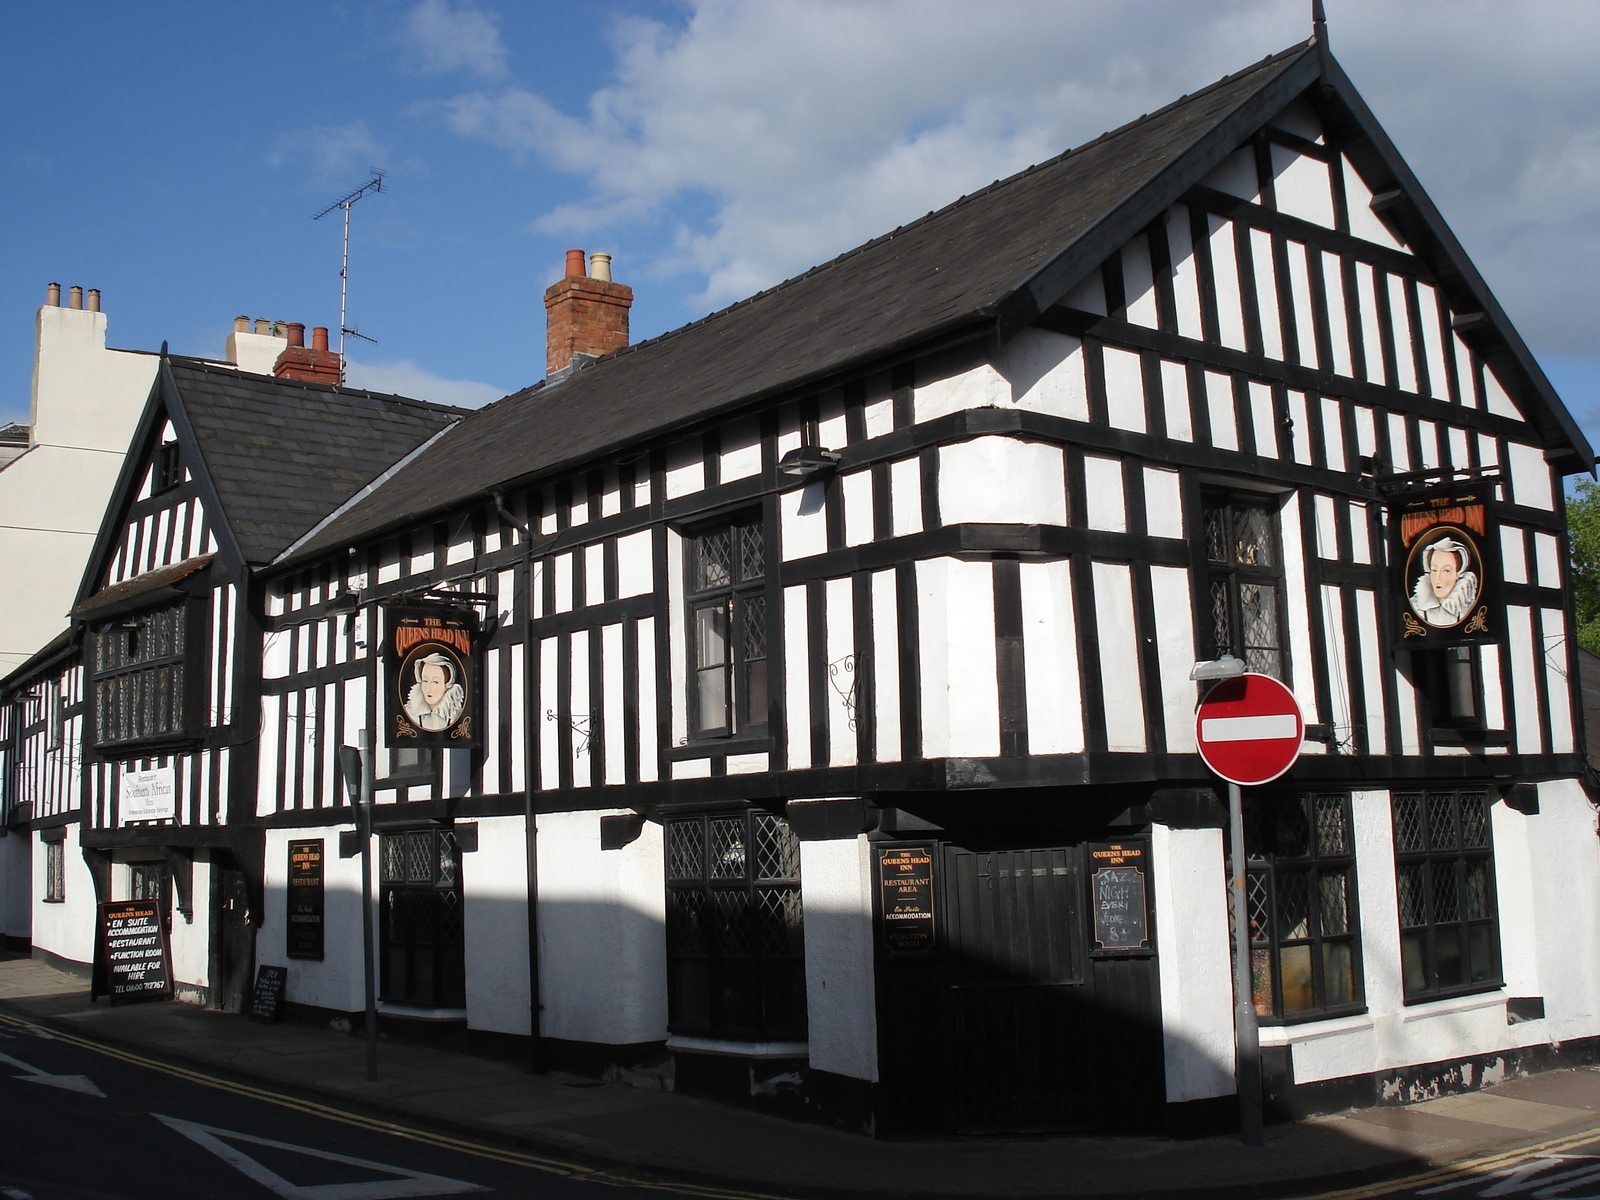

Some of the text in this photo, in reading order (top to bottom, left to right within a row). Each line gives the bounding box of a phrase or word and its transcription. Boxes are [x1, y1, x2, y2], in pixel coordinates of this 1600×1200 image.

[1430, 497, 1450, 507] THE
[1401, 504, 1485, 549] QUEENS HEAD INN
[423, 618, 441, 626] THE
[396, 626, 471, 658] QUEENS HEAD INN
[151, 782, 171, 796] African
[292, 853, 320, 862] QUEENS HEAD
[1093, 851, 1120, 859] QUEENS
[884, 878, 930, 886] RESTAURANT
[108, 911, 135, 919] QUEENS
[112, 917, 149, 927] EN SUITE
[107, 925, 159, 937] ACCOMMODATION
[112, 937, 157, 948] RESTAURANT
[113, 948, 162, 960] FUNCTION ROOM
[113, 961, 161, 973] AVAILABLE FOR
[127, 971, 146, 980] HIRE
[115, 980, 165, 993] TEL 01600 712767
